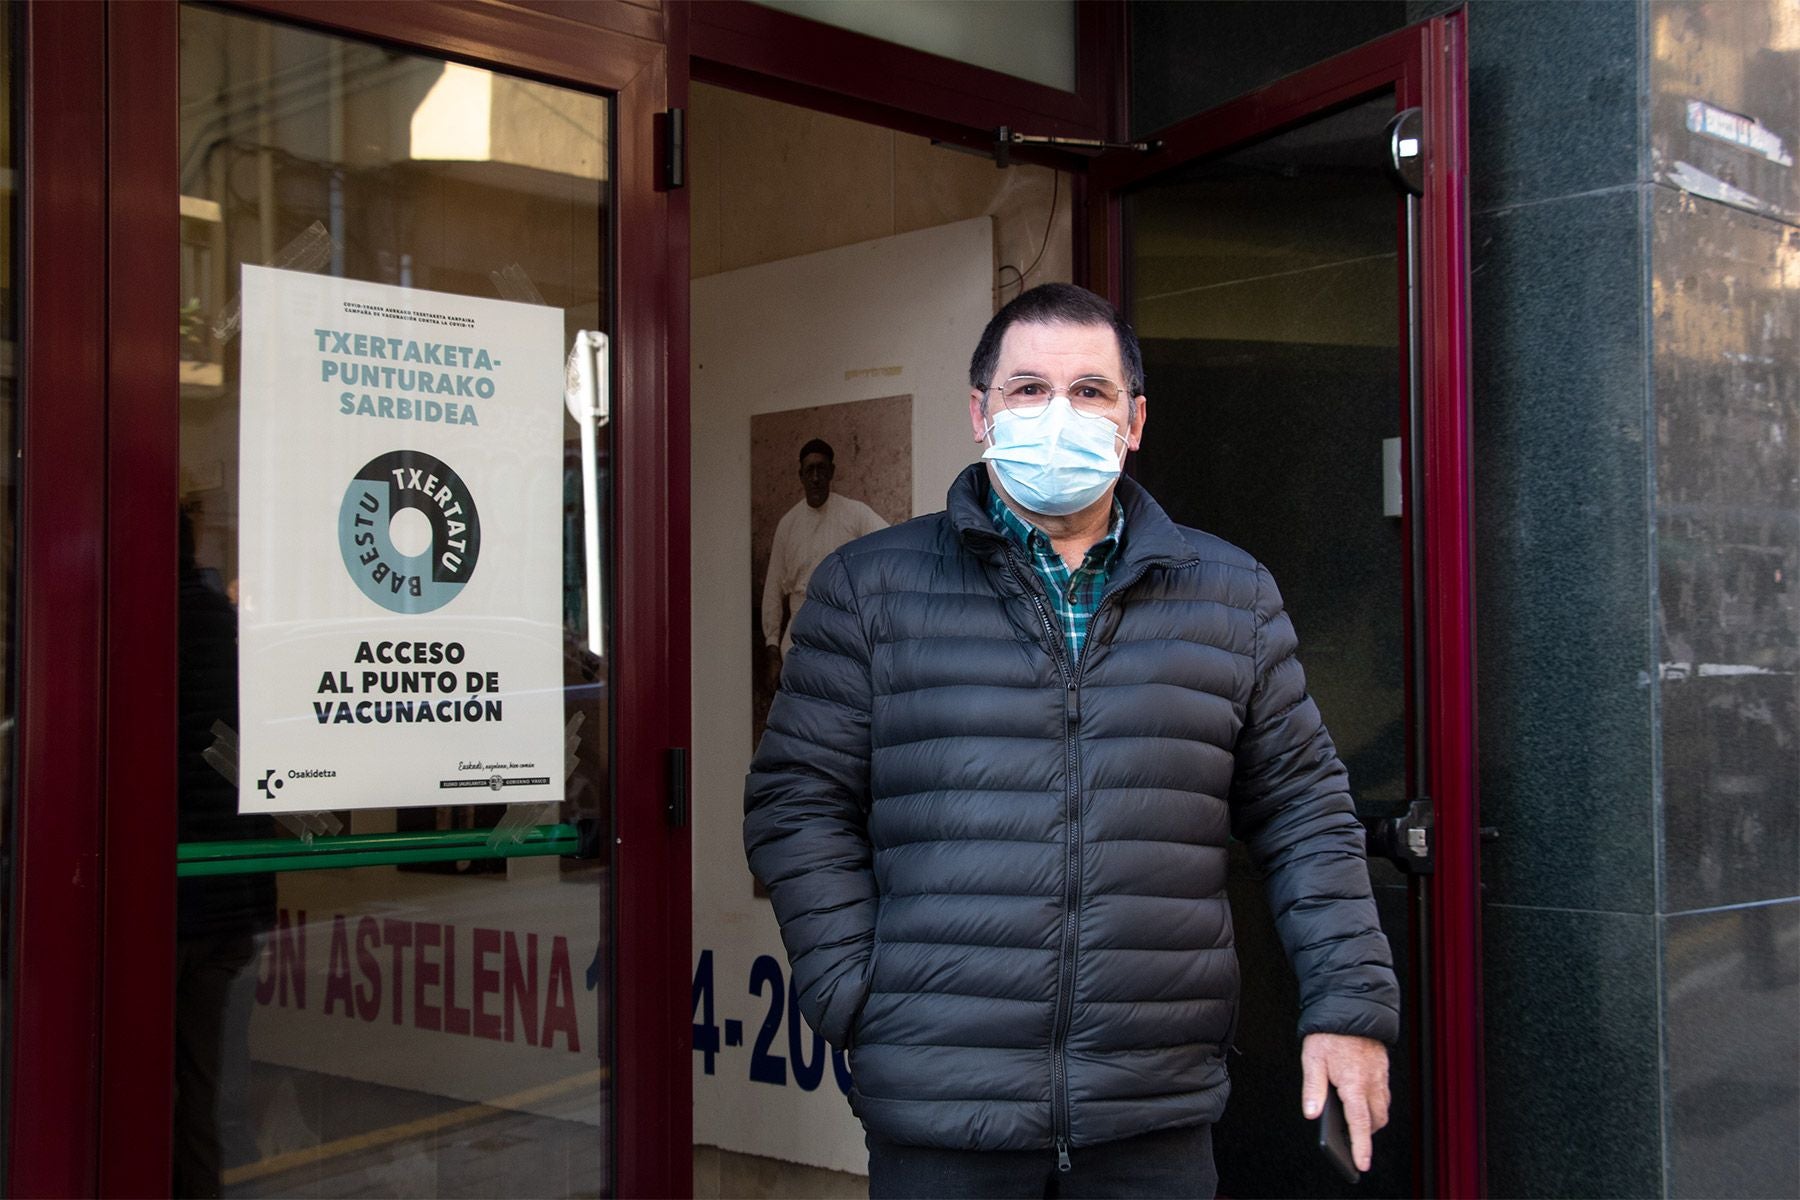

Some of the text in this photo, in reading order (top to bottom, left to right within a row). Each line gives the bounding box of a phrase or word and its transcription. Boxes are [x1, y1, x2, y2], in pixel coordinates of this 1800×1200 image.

[418, 317, 440, 325] CONTRA
[314, 328, 502, 371] TXERTAKETA-
[321, 360, 496, 399] PUNTURAKO
[339, 392, 479, 426] SARBIDEA
[391, 467, 467, 573] TXERTATU
[354, 491, 422, 597] BABESTU
[354, 641, 466, 665] ACCESO
[317, 671, 500, 694] AL PUNTO DE
[313, 695, 503, 724] VACUNACIÓN
[288, 769, 337, 779] Osakidetza
[324, 913, 581, 1053] ASTELENA
